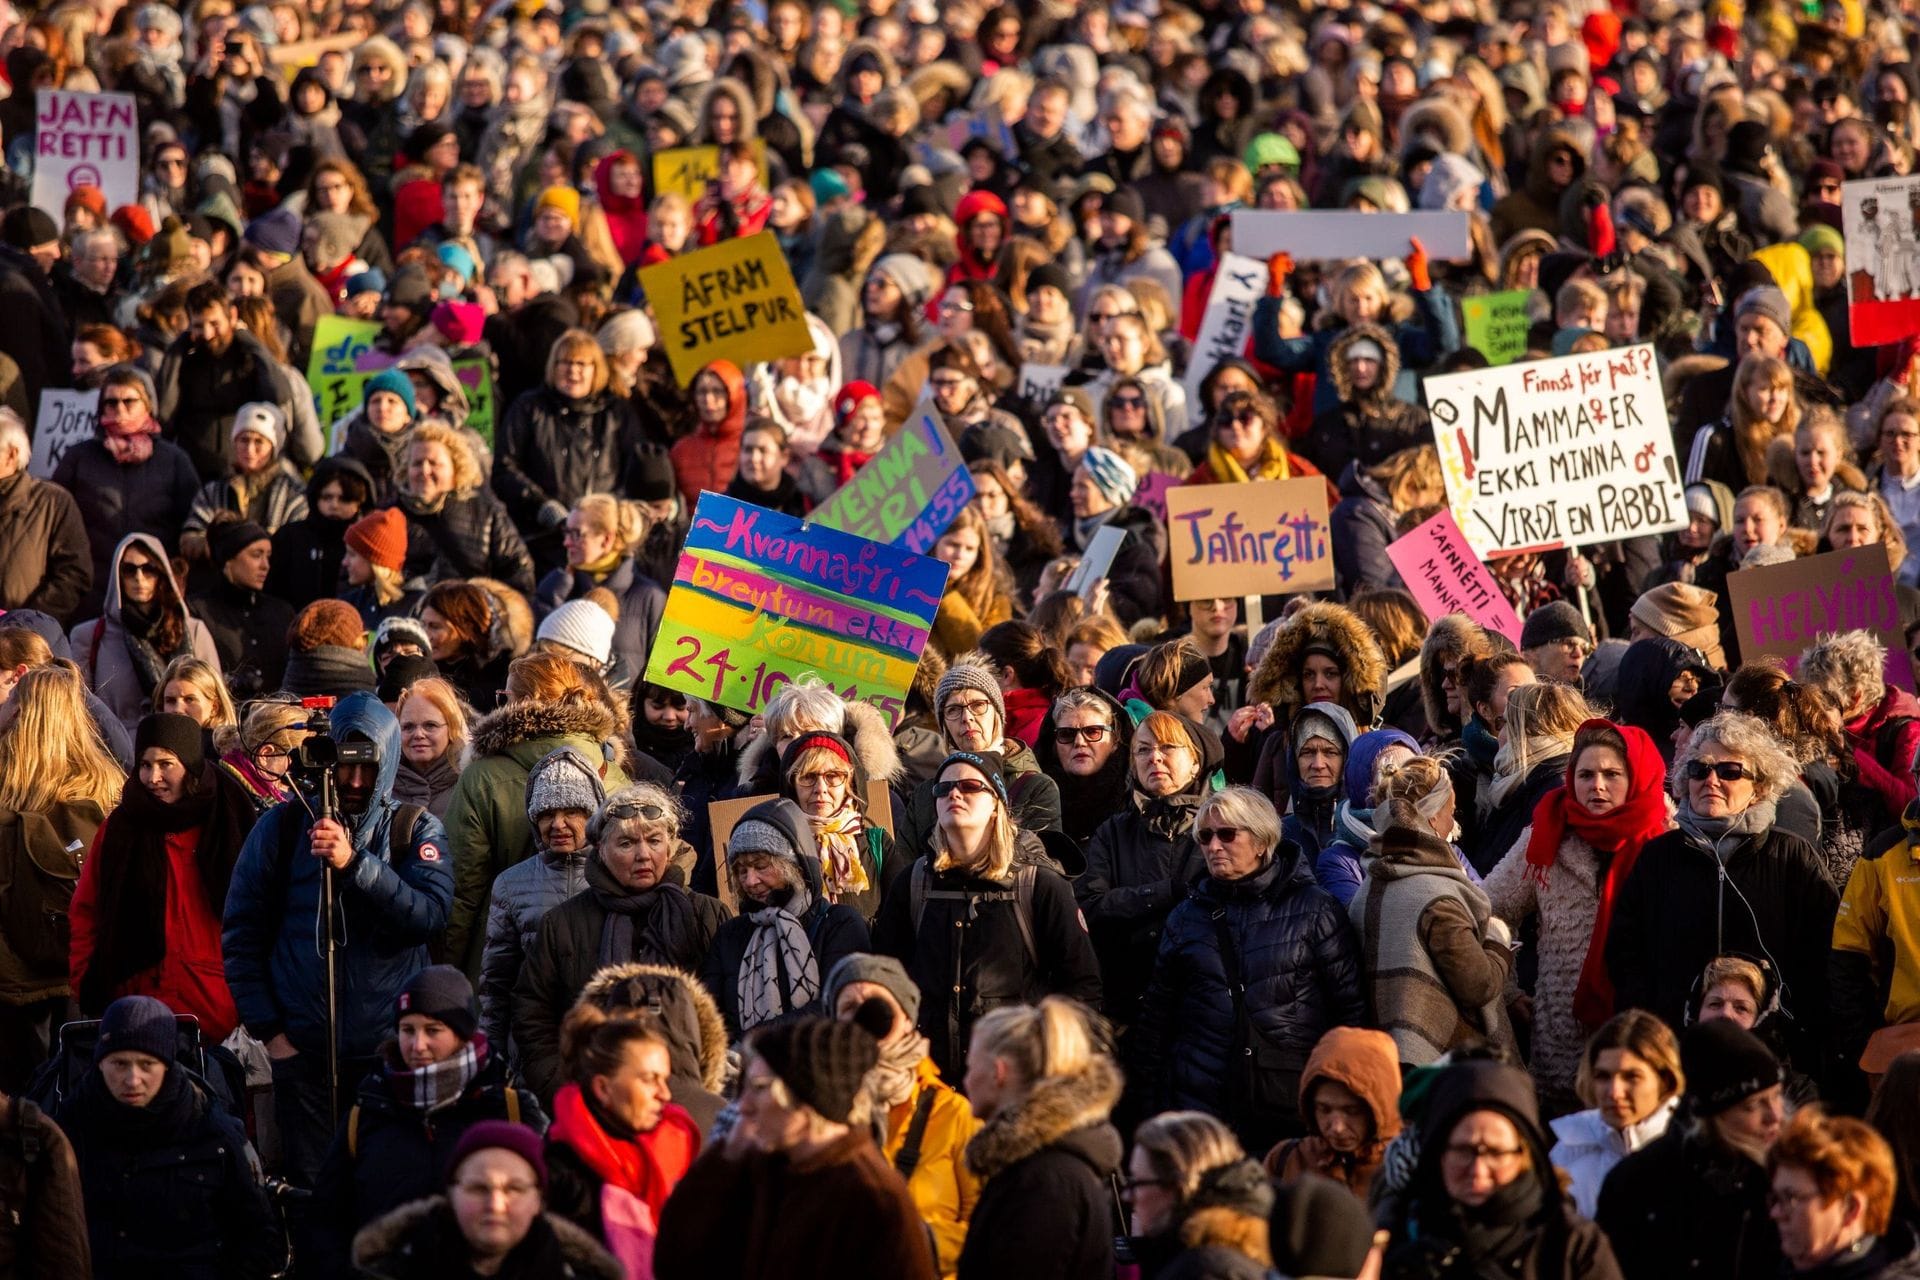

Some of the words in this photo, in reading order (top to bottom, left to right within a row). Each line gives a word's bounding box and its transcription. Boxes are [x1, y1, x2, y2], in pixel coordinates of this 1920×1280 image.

[38, 94, 133, 128] JAFN
[681, 257, 770, 315] ÁFRAM
[679, 296, 799, 351] STELPUR
[1522, 367, 1574, 394] Finnst
[1578, 362, 1602, 395] þér
[1472, 386, 1596, 462] MAMMA
[1610, 393, 1644, 430] ER
[1477, 460, 1540, 497] EKKI
[1549, 440, 1627, 483] MINNA
[1472, 500, 1563, 548] VIRÐI
[1567, 503, 1595, 536] EN
[691, 557, 836, 629] breytum
[846, 615, 915, 651] ekki
